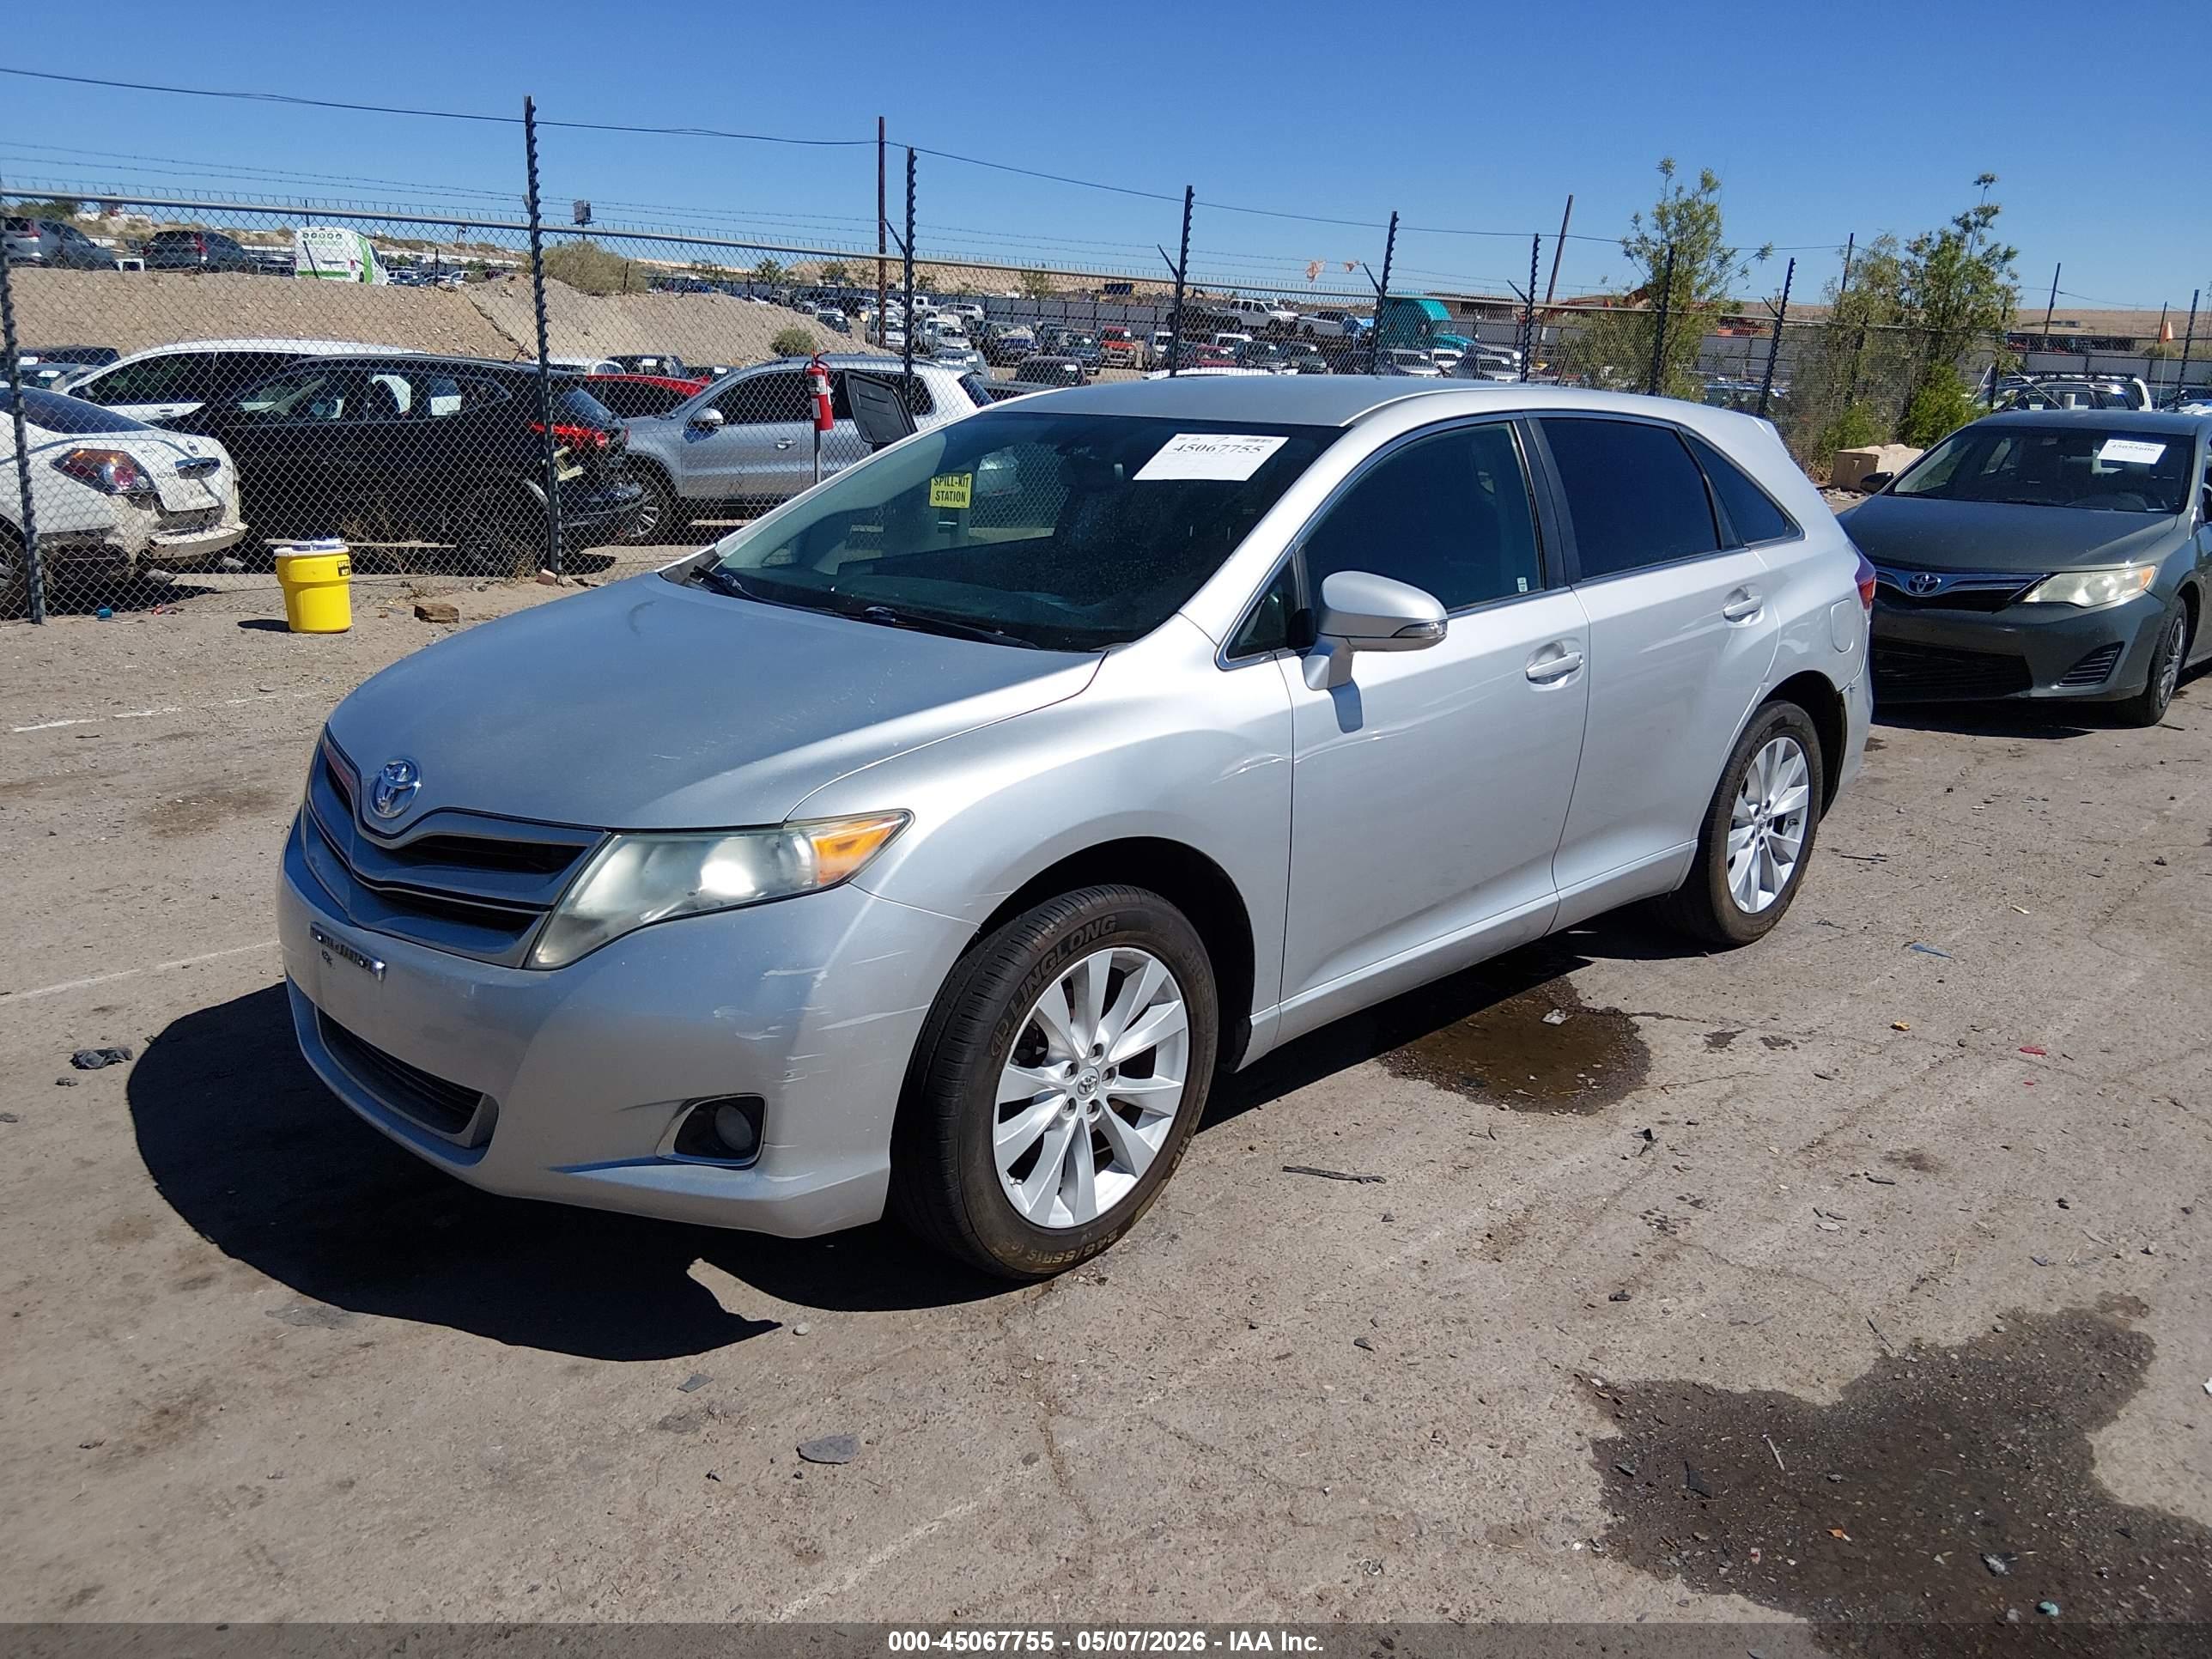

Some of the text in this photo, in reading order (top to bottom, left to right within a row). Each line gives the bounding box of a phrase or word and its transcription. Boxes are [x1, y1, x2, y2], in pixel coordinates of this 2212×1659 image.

[1173, 443, 1265, 453] 45067755
[933, 475, 970, 489] SPILL-KIT
[935, 490, 966, 502] STATION
[1009, 915, 1117, 1019] LINGLONG
